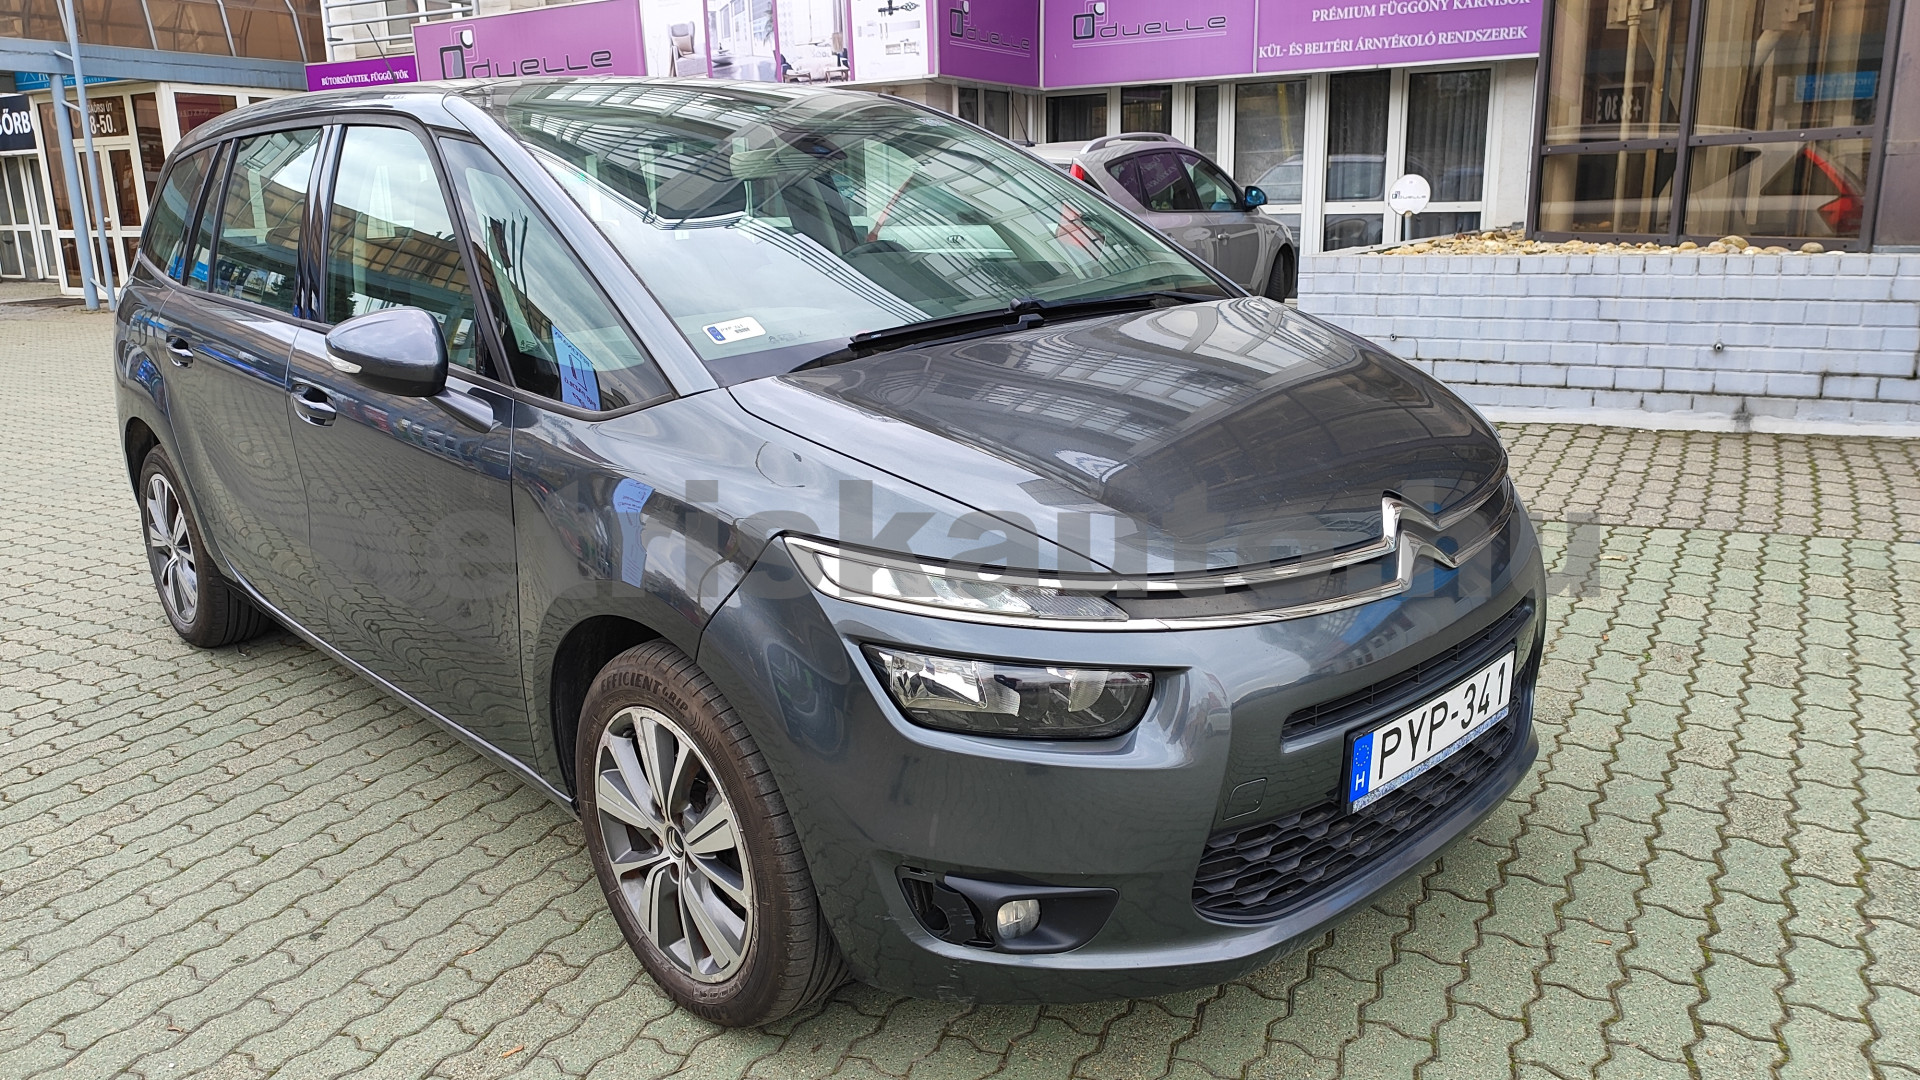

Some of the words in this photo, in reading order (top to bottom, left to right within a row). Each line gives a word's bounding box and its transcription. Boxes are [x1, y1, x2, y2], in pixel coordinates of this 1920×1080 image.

[1312, 4, 1376, 22] PRÉMIUM
[1259, 43, 1287, 58] KÜL-
[1289, 42, 1303, 56] ÉS
[1304, 38, 1353, 55] BELTÉRI
[1355, 30, 1436, 51] ÁRNYÉKOLÓ
[1438, 26, 1528, 45] RENDSZEREK
[0, 108, 33, 136] ŐRB
[1378, 662, 1506, 781] PYP-341
[1355, 771, 1366, 792] H
